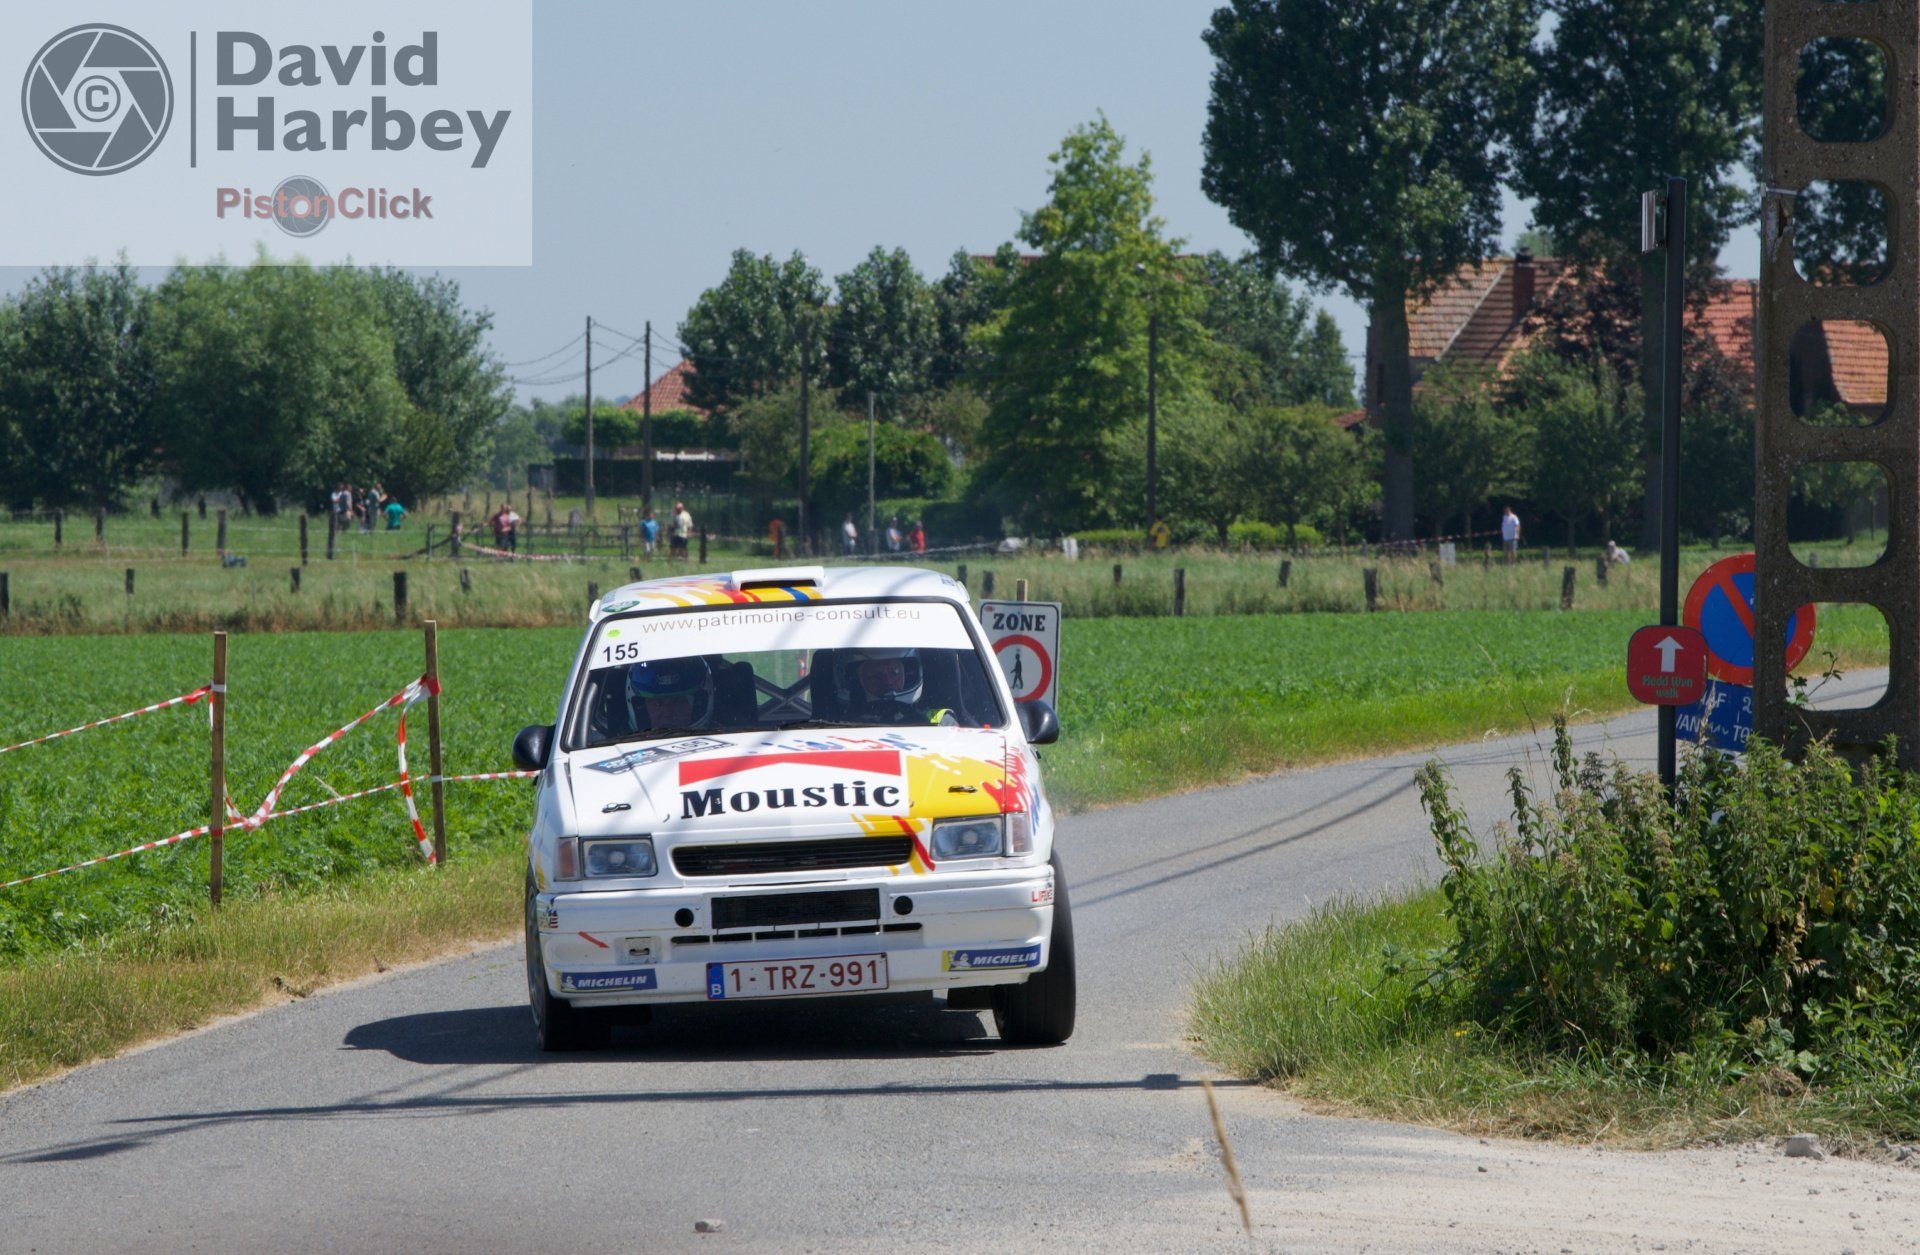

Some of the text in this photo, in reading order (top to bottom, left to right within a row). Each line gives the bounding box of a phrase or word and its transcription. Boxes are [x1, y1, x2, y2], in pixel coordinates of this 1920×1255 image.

[642, 606, 921, 633] www.patrimoine-consult.eu
[993, 613, 1046, 632] ZONE
[603, 642, 639, 662] 155
[681, 780, 900, 820] Moustic
[973, 952, 1039, 966] MICHELIN
[578, 975, 647, 988] MICHELIN
[712, 983, 722, 996] B
